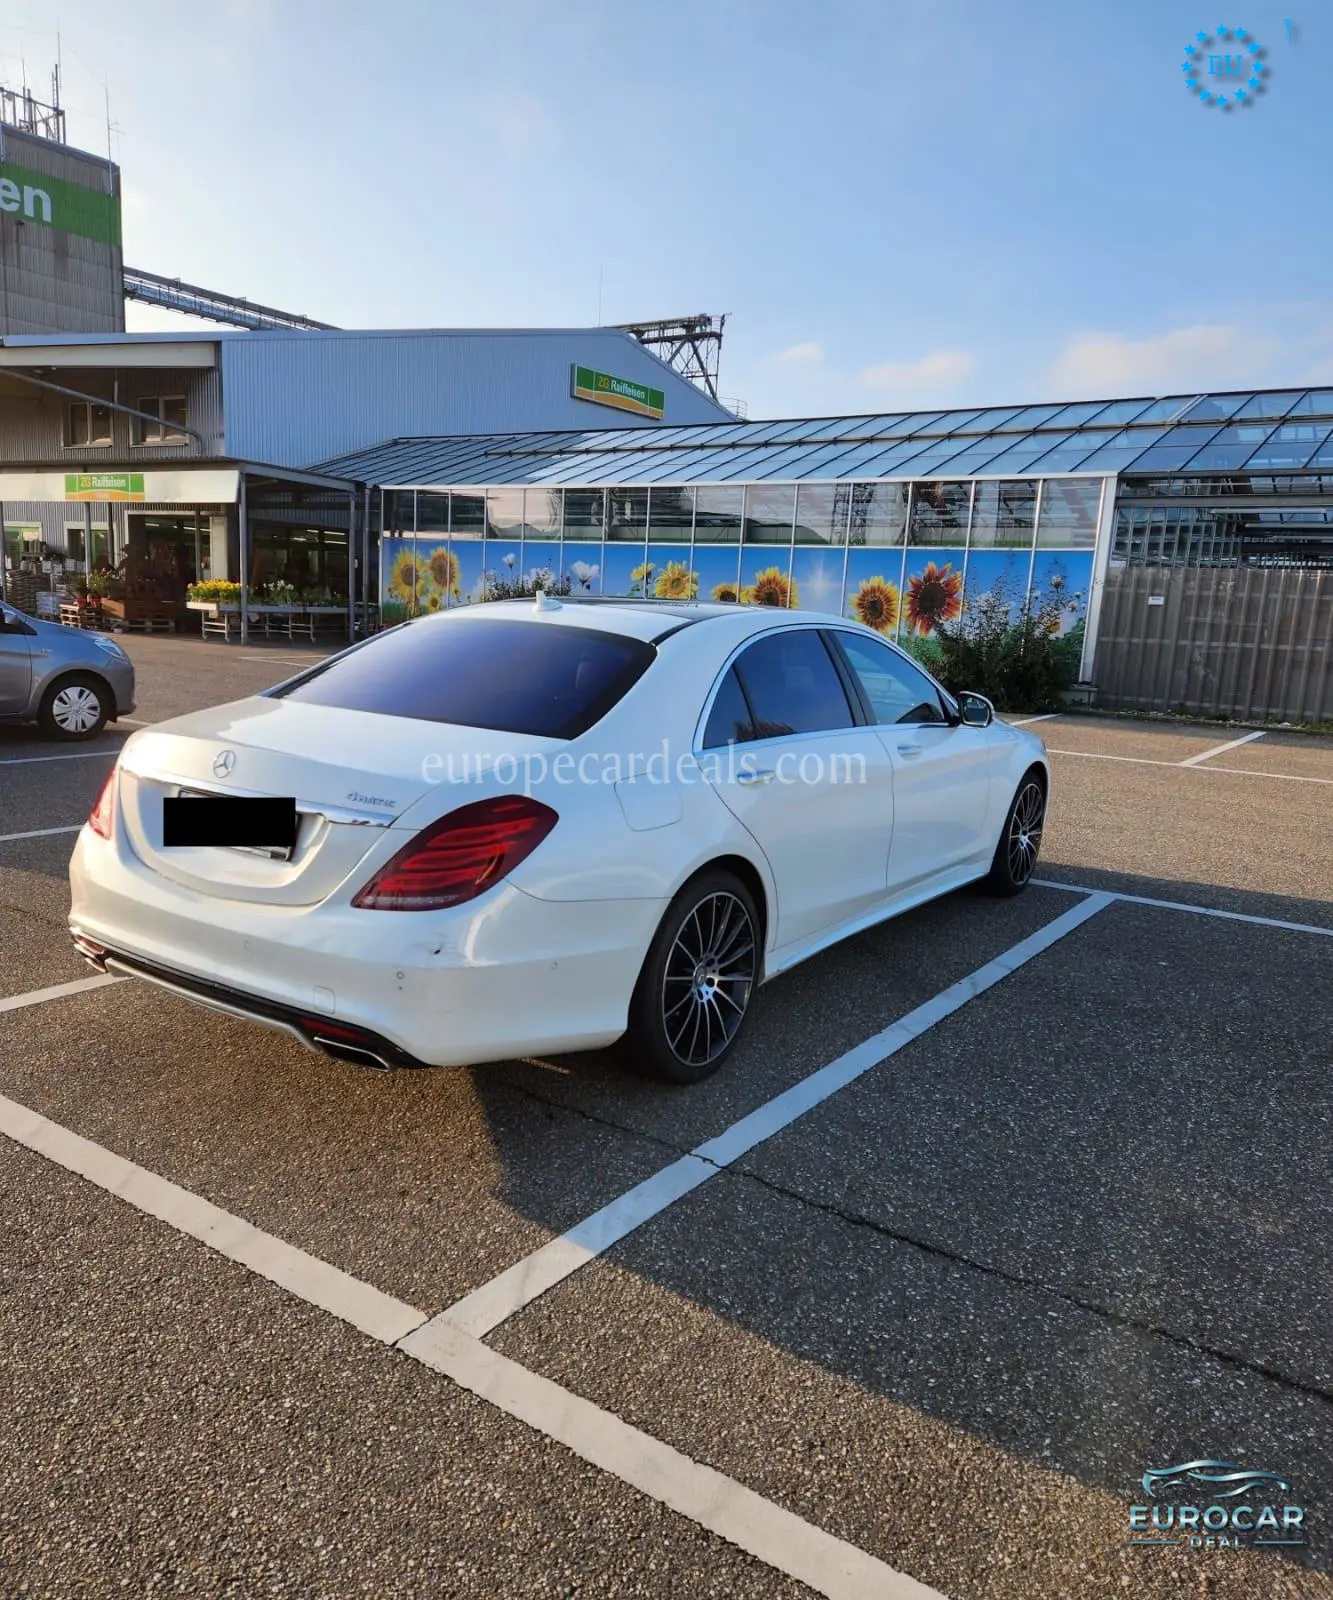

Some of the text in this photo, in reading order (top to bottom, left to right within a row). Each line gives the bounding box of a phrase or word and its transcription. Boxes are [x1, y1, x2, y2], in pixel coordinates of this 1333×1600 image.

[0, 177, 53, 223] en
[610, 379, 646, 399] Raiffeisen
[92, 476, 126, 488] Raiffeisen
